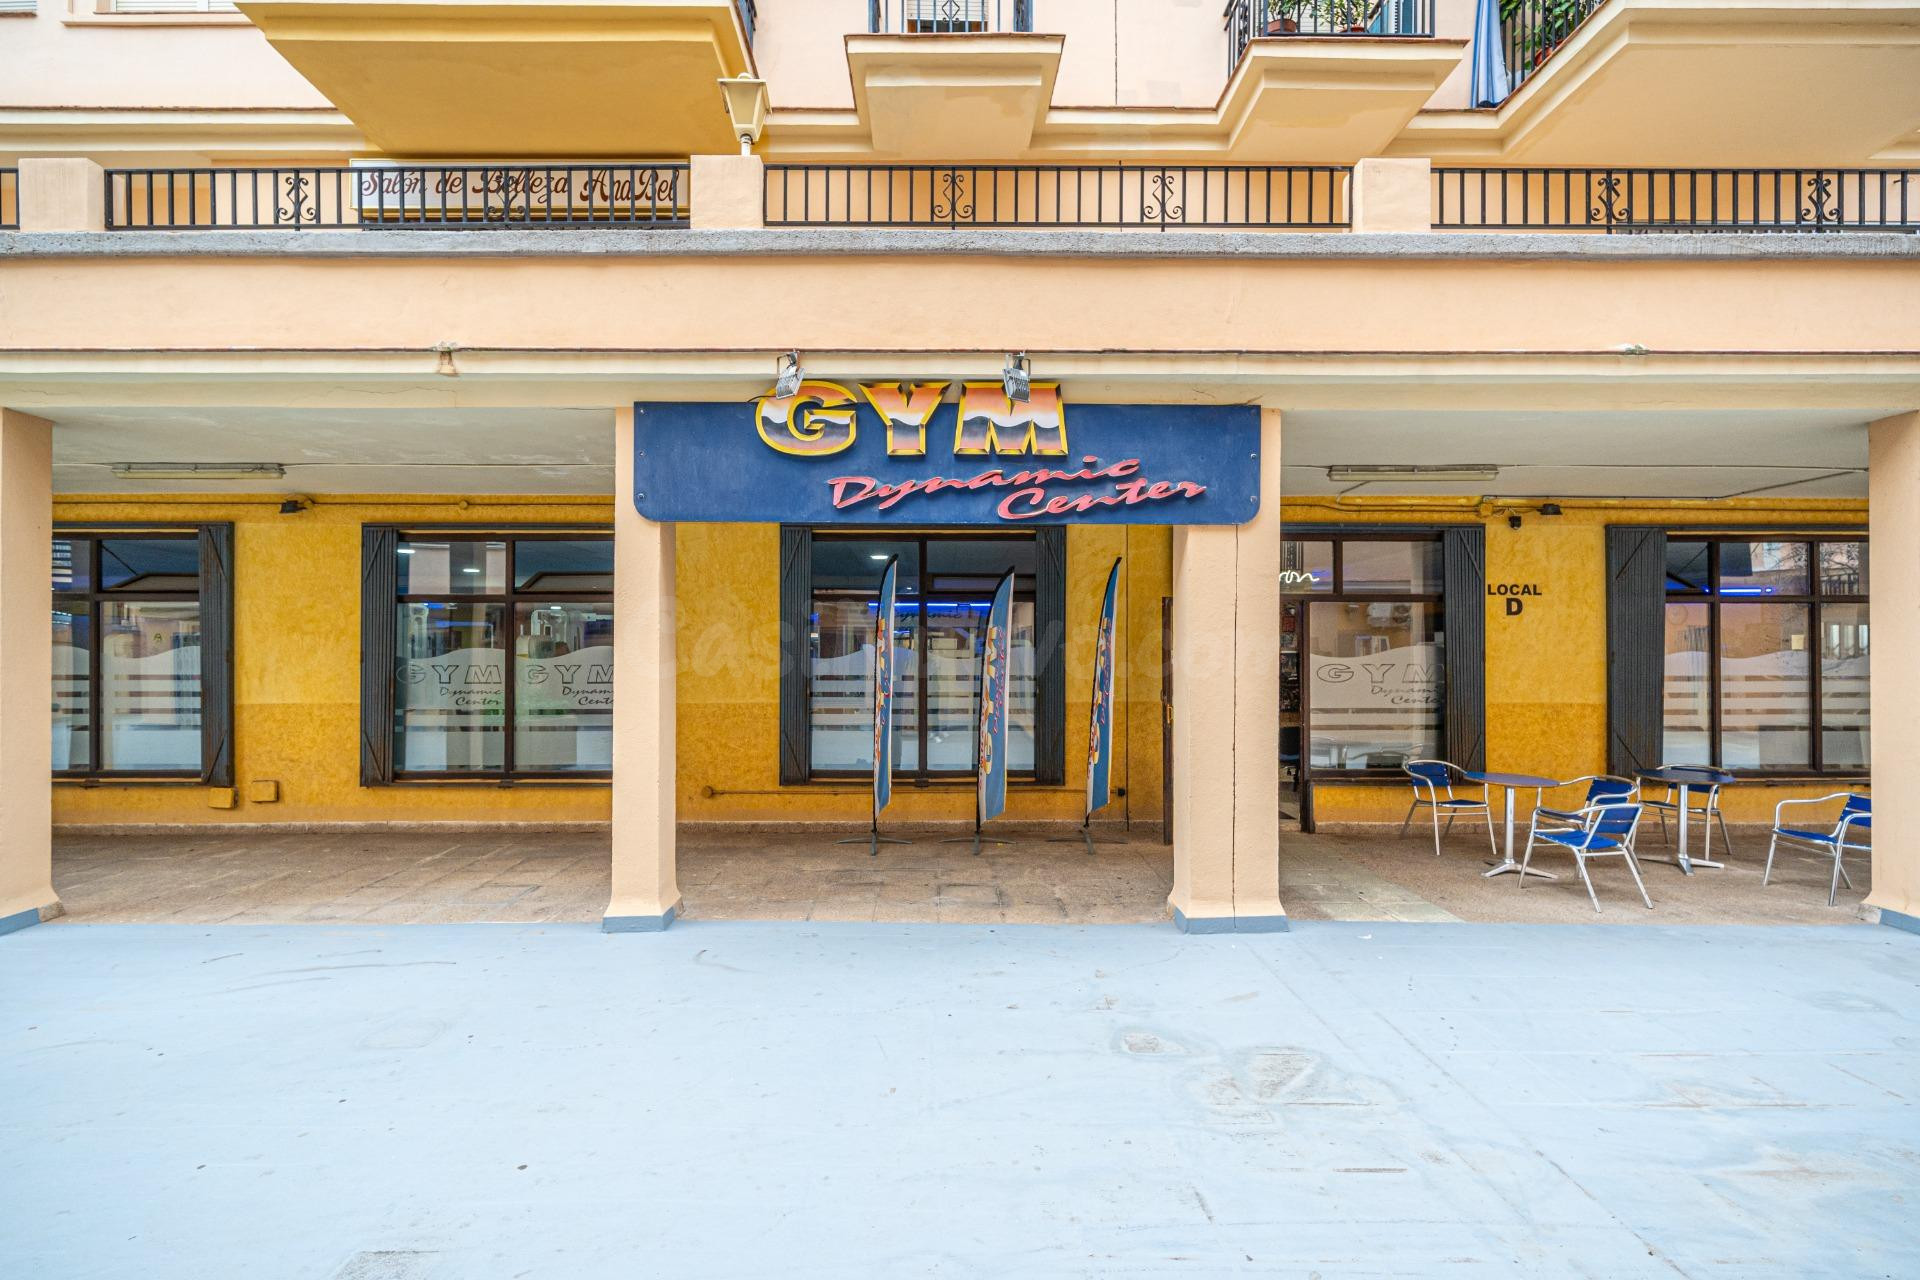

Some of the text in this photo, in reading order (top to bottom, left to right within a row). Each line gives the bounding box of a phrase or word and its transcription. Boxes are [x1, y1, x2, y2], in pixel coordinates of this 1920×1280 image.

[361, 170, 427, 197] Salón
[435, 170, 463, 194] de
[472, 168, 569, 204] Belleza
[755, 380, 1070, 456] GYM
[828, 456, 1141, 511] Dynamic
[997, 480, 1207, 520] Center
[1487, 584, 1542, 596] LOCAL
[1505, 598, 1523, 616] D
[396, 664, 502, 684] GYM
[527, 664, 613, 684] GYM
[1317, 663, 1445, 683] GYM
[440, 687, 502, 698] Dynamic
[456, 697, 501, 706] Center
[562, 686, 613, 698] Dynam
[982, 626, 998, 775] GYM
